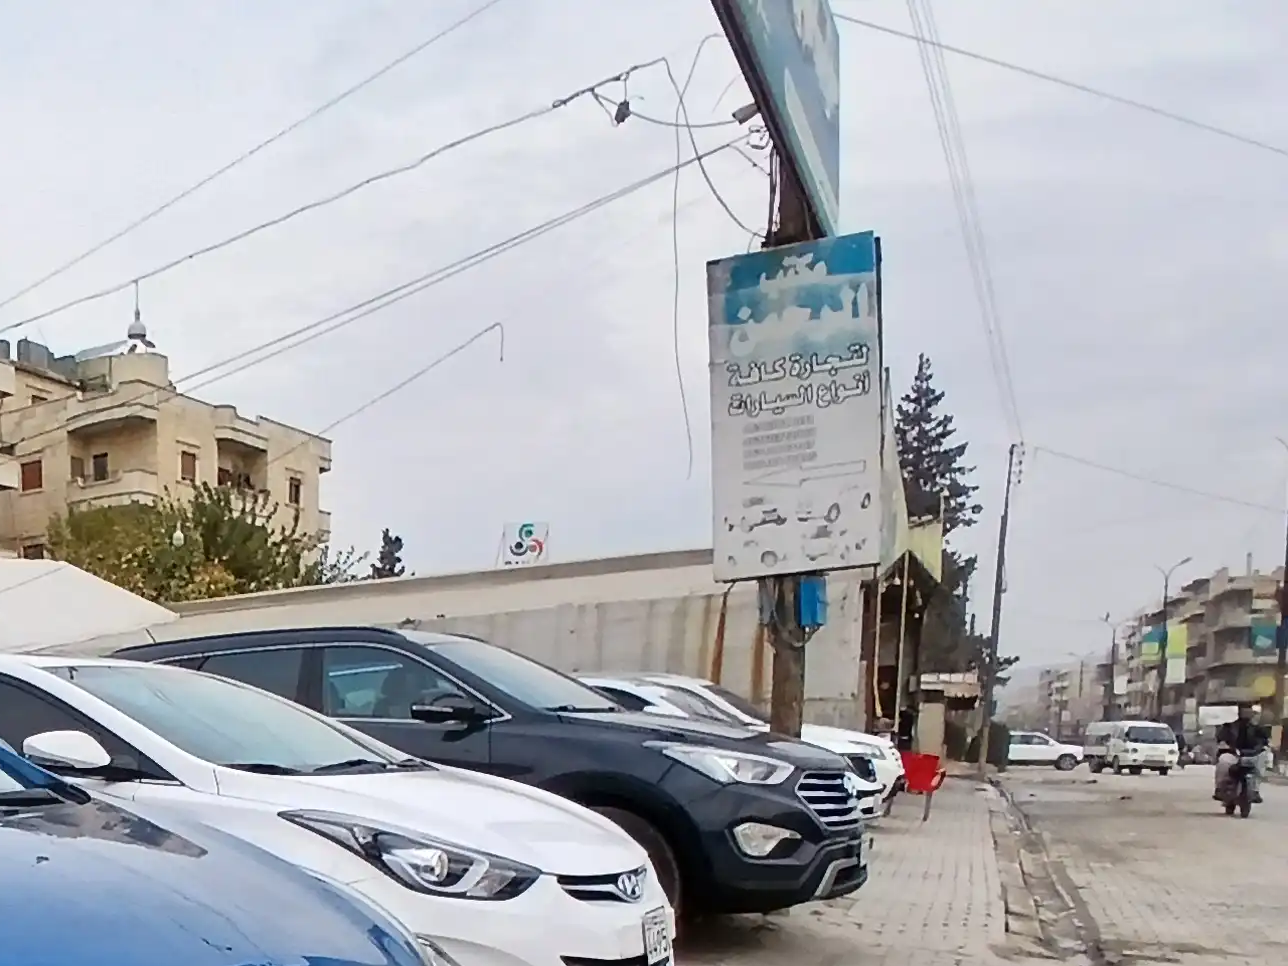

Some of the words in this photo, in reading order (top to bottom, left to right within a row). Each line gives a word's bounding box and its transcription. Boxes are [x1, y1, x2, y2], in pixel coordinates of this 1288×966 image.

[726, 357, 787, 387] كافة
[789, 342, 870, 381] لتجارة
[728, 383, 814, 418] السيارات
